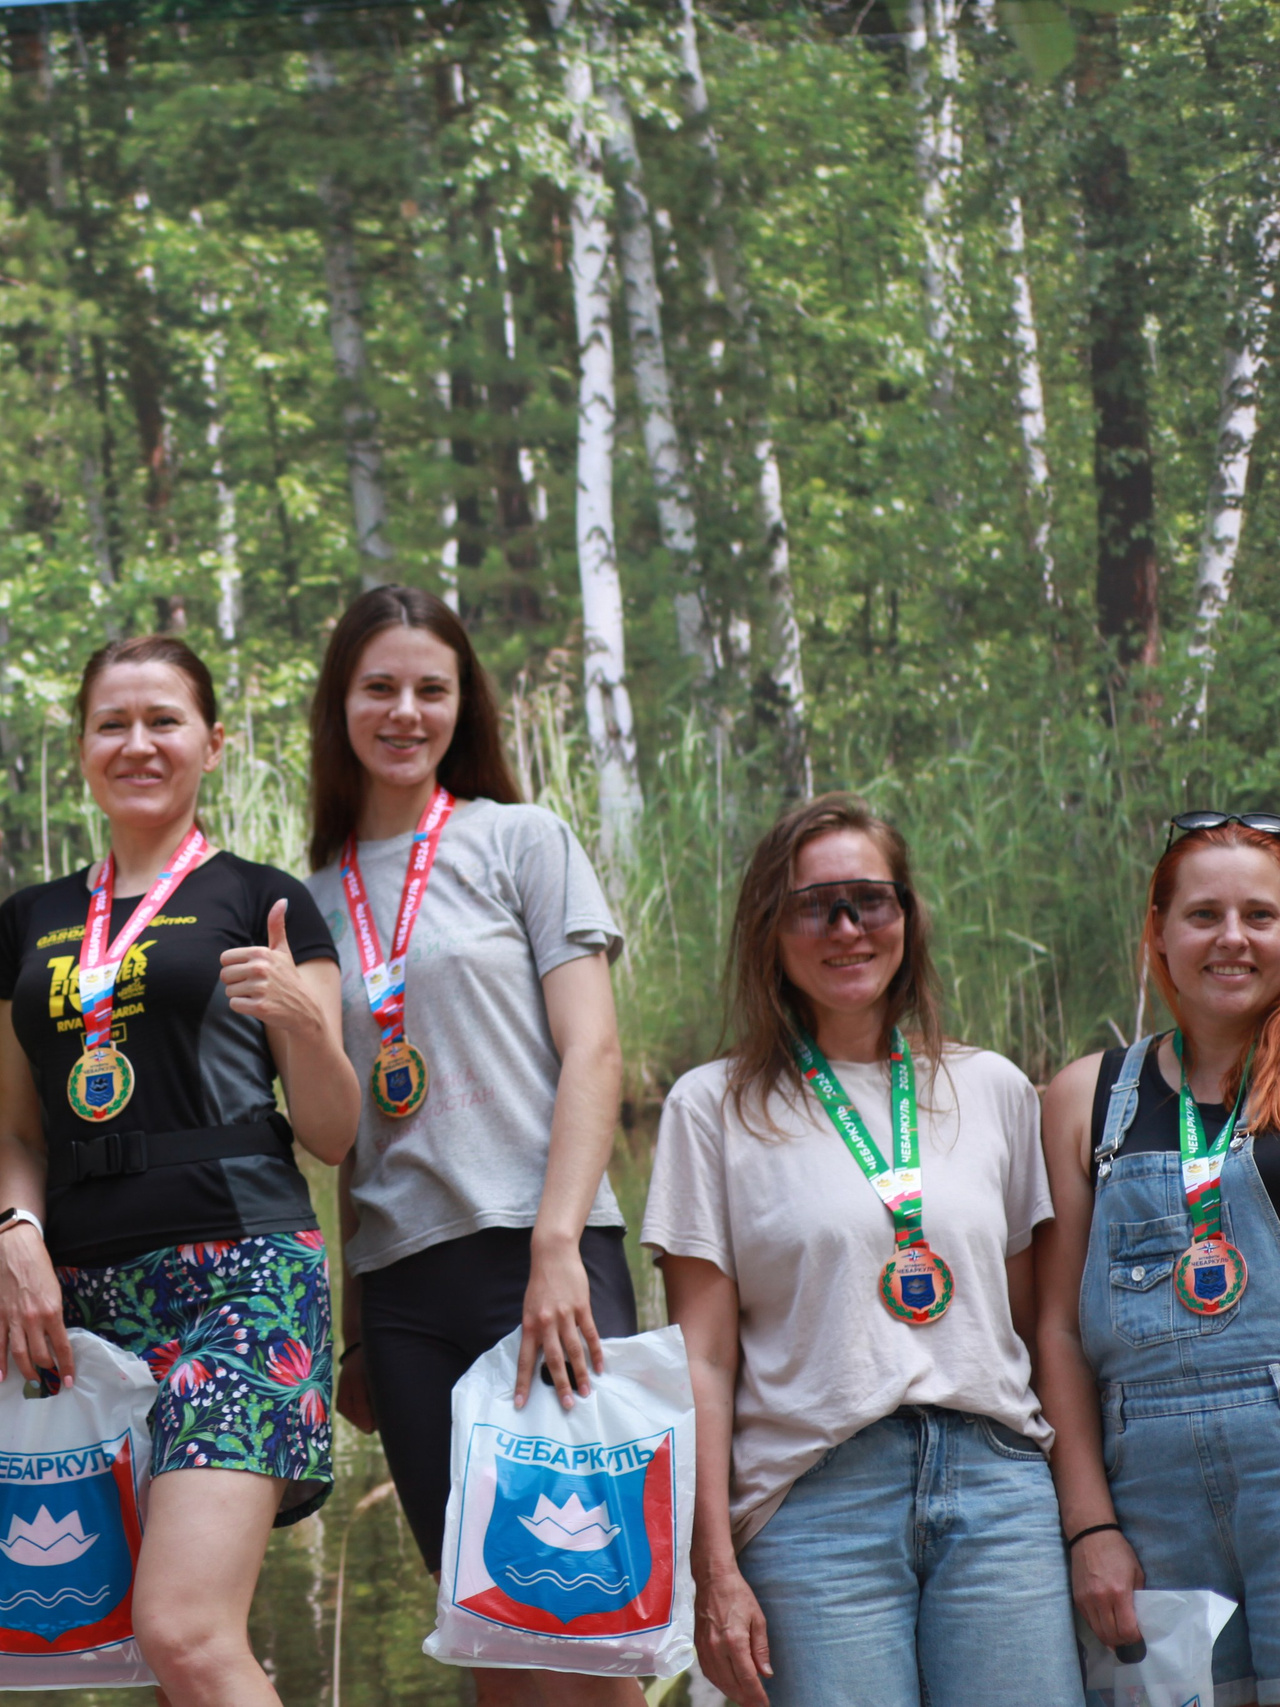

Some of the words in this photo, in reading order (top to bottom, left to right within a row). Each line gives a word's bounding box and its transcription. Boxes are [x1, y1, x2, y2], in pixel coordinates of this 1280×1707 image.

[56, 1017, 84, 1033] RIVA
[837, 1105, 877, 1170] ЧЕБАРКУЛЬ
[900, 1098, 911, 1164] ЧЕБАРКУЛЬ
[1185, 1096, 1198, 1155] ЧЕБАРКУЛЬ
[1190, 1257, 1229, 1267] ЧЕБАРКУЛЬ
